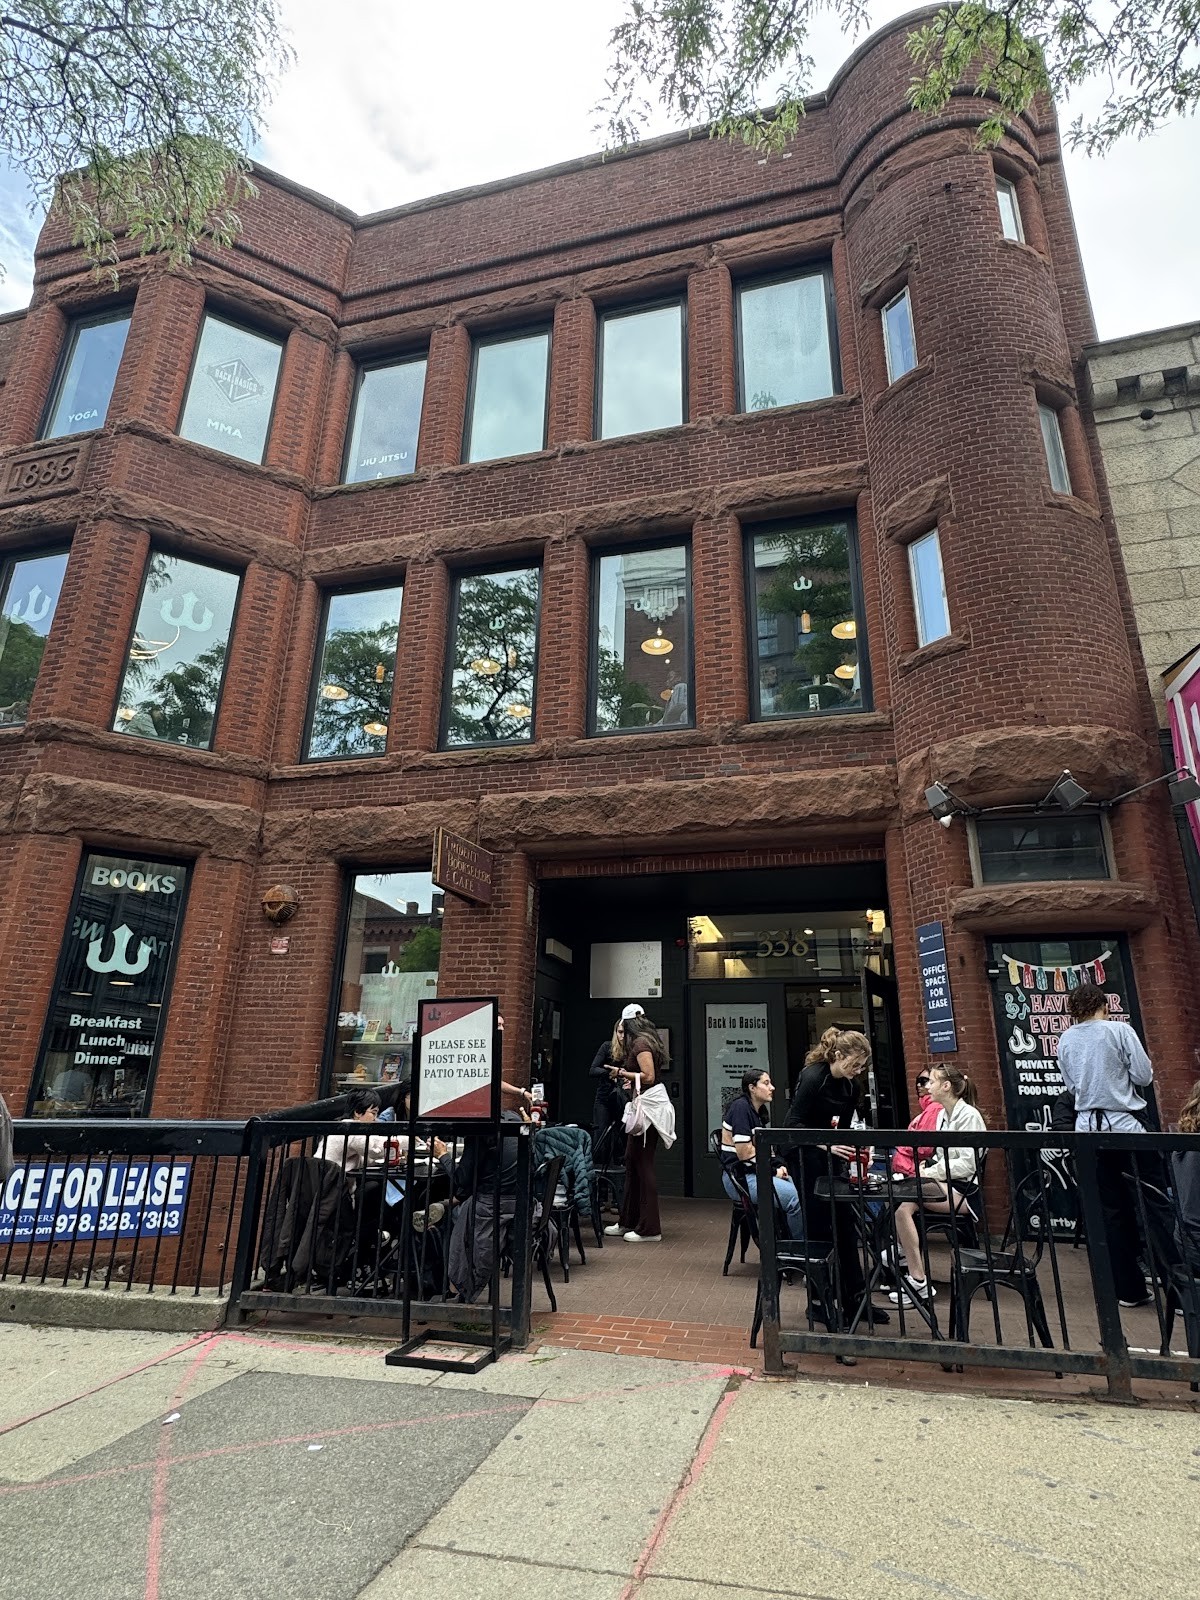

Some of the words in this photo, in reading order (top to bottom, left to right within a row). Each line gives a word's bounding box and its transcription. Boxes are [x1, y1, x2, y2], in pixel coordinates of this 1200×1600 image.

[234, 376, 258, 393] BASICS
[68, 409, 98, 423] YOGA
[206, 418, 243, 439] MMA
[360, 457, 376, 467] JIU
[378, 451, 408, 464] JITSU
[9, 456, 77, 493] 1886
[447, 851, 492, 885] BOOKSELLERS
[91, 866, 177, 894] BOOKS
[756, 930, 809, 957] 338
[922, 963, 946, 977] OFFICE
[925, 975, 946, 988] SPACE
[930, 987, 944, 998] FOR
[928, 998, 949, 1010] LEASE
[69, 1013, 143, 1029] Breakfast
[708, 1016, 726, 1029] Back
[739, 1016, 766, 1029] Basics
[1029, 1015, 1078, 1033] EVEN
[79, 1033, 126, 1047] Lunch
[428, 1039, 466, 1050] PLEASE
[467, 1039, 487, 1049] SEE
[73, 1051, 126, 1066] Dinner
[427, 1055, 454, 1064] HOST
[457, 1054, 477, 1064] FOR
[479, 1053, 487, 1063] A
[1015, 1060, 1055, 1070] PRIVATE
[424, 1069, 454, 1079] PATIO
[456, 1068, 490, 1078] TABLE
[1019, 1072, 1043, 1083] FULL
[1043, 1073, 1064, 1083] SER
[45, 1167, 104, 1209] FOR
[105, 1166, 187, 1207] LEASE
[55, 1210, 180, 1234] 978.828.7383
